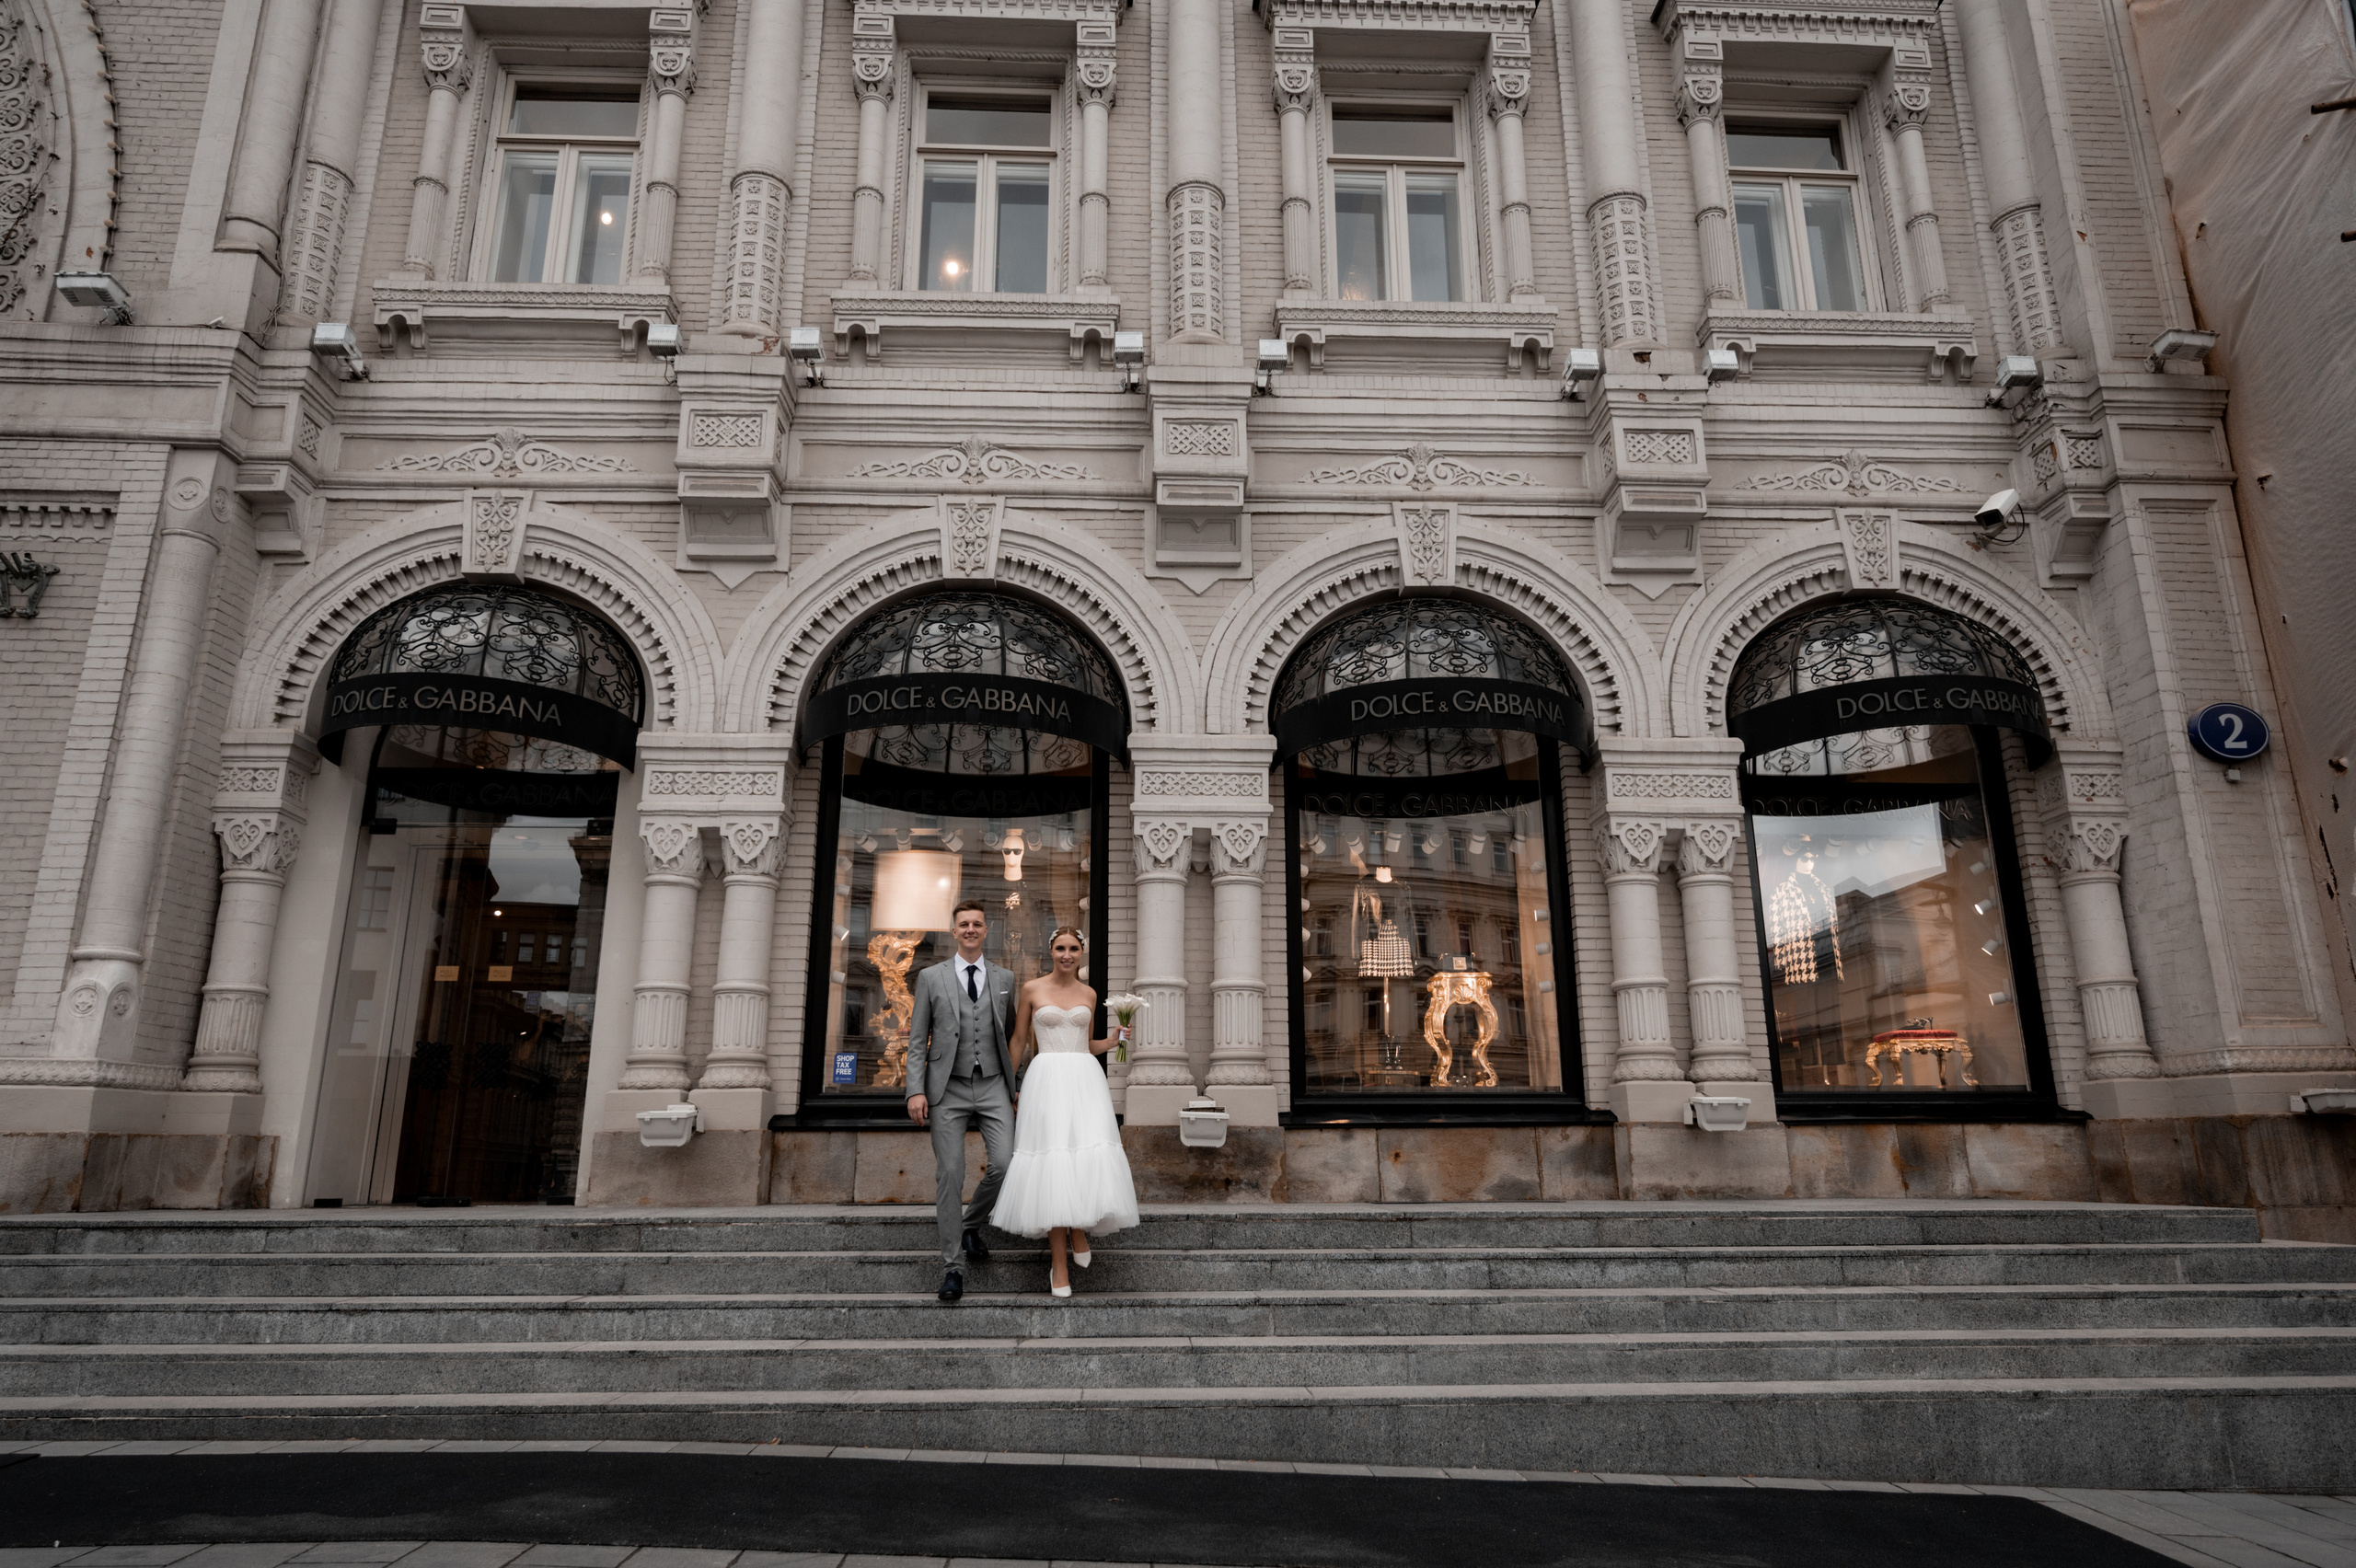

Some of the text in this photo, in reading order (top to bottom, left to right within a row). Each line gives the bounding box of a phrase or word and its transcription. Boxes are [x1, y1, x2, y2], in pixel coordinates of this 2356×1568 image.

[330, 686, 563, 727] DOLCE & GABBANA
[847, 686, 1073, 724] DOLCE & GABBANA
[1350, 689, 1566, 727] DOLCE & GABBANA
[1836, 686, 2044, 723] DOLCE & GABBANA
[2218, 713, 2248, 749] 2
[1304, 792, 1385, 817] DOLCE
